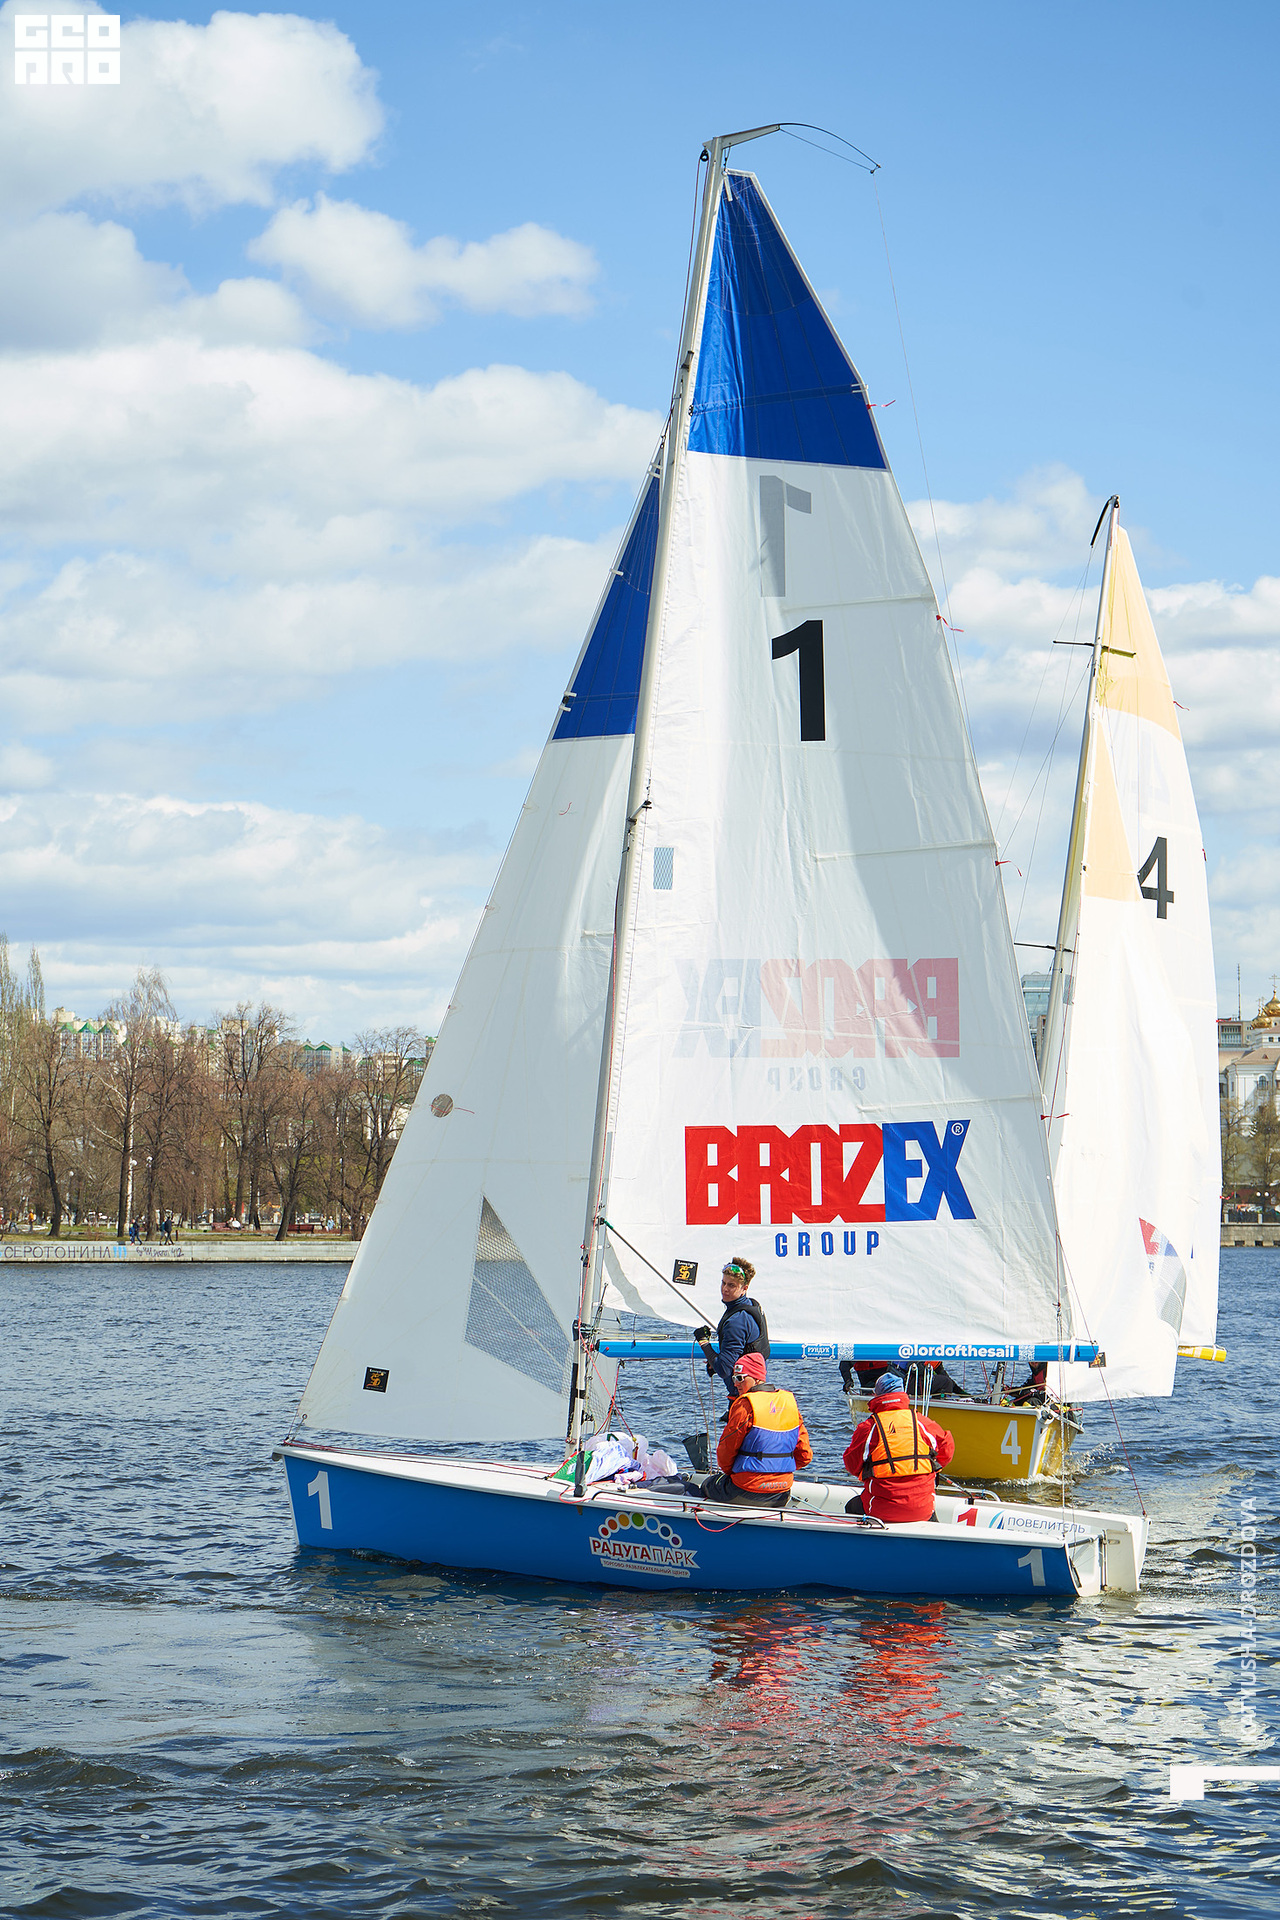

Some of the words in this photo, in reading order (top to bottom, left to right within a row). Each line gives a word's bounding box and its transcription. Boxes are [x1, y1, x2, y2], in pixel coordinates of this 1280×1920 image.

[772, 620, 826, 741] 1
[1137, 836, 1174, 919] 4
[685, 1119, 977, 1225] BROZEX
[4, 1246, 111, 1259] СЕРОТОНИНА
[775, 1230, 880, 1257] GROUP
[898, 1344, 1014, 1359] @lordofthesail
[1001, 1420, 1021, 1465] 4
[307, 1471, 333, 1530] 1
[758, 1481, 788, 1489] MUSTO
[1007, 1517, 1086, 1534] ПОВЕЛИТЕЛЬ
[592, 1540, 694, 1566] РАДУГАПАРК
[1017, 1549, 1046, 1586] 1
